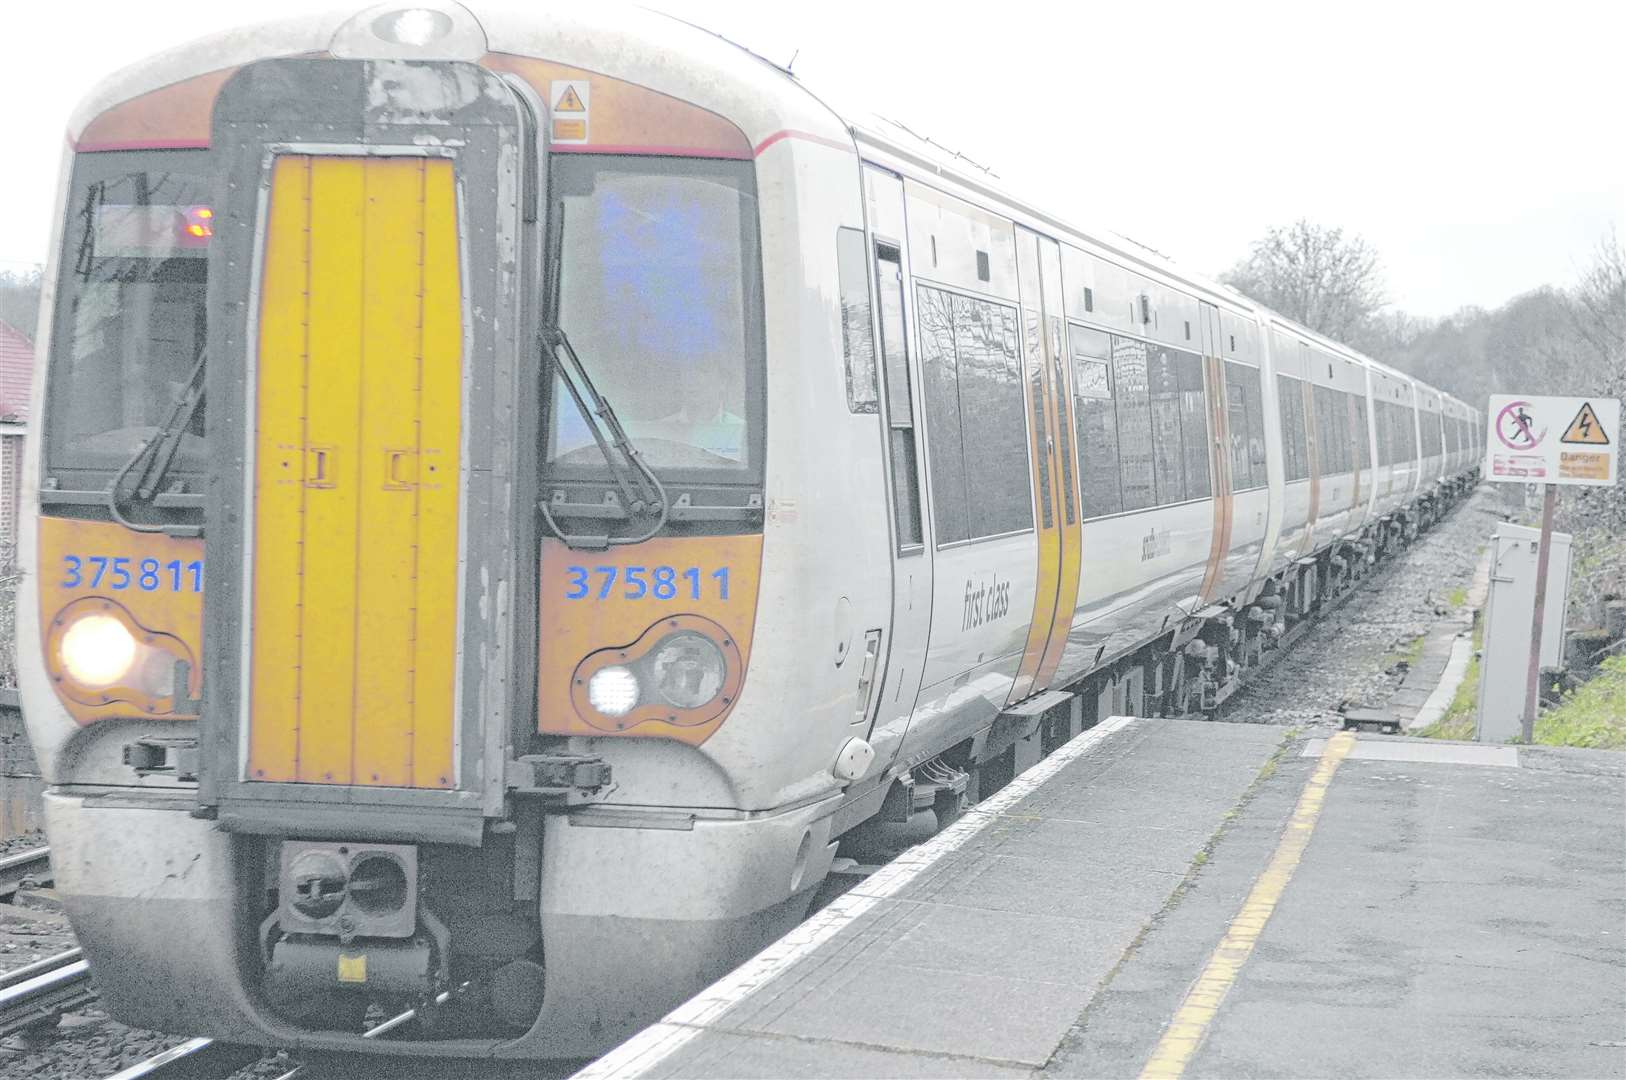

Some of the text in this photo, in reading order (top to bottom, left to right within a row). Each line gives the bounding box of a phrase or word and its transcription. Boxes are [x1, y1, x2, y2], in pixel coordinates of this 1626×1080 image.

[62, 555, 204, 593] 375811
[564, 565, 730, 601] 375811
[961, 572, 1010, 633] first class
